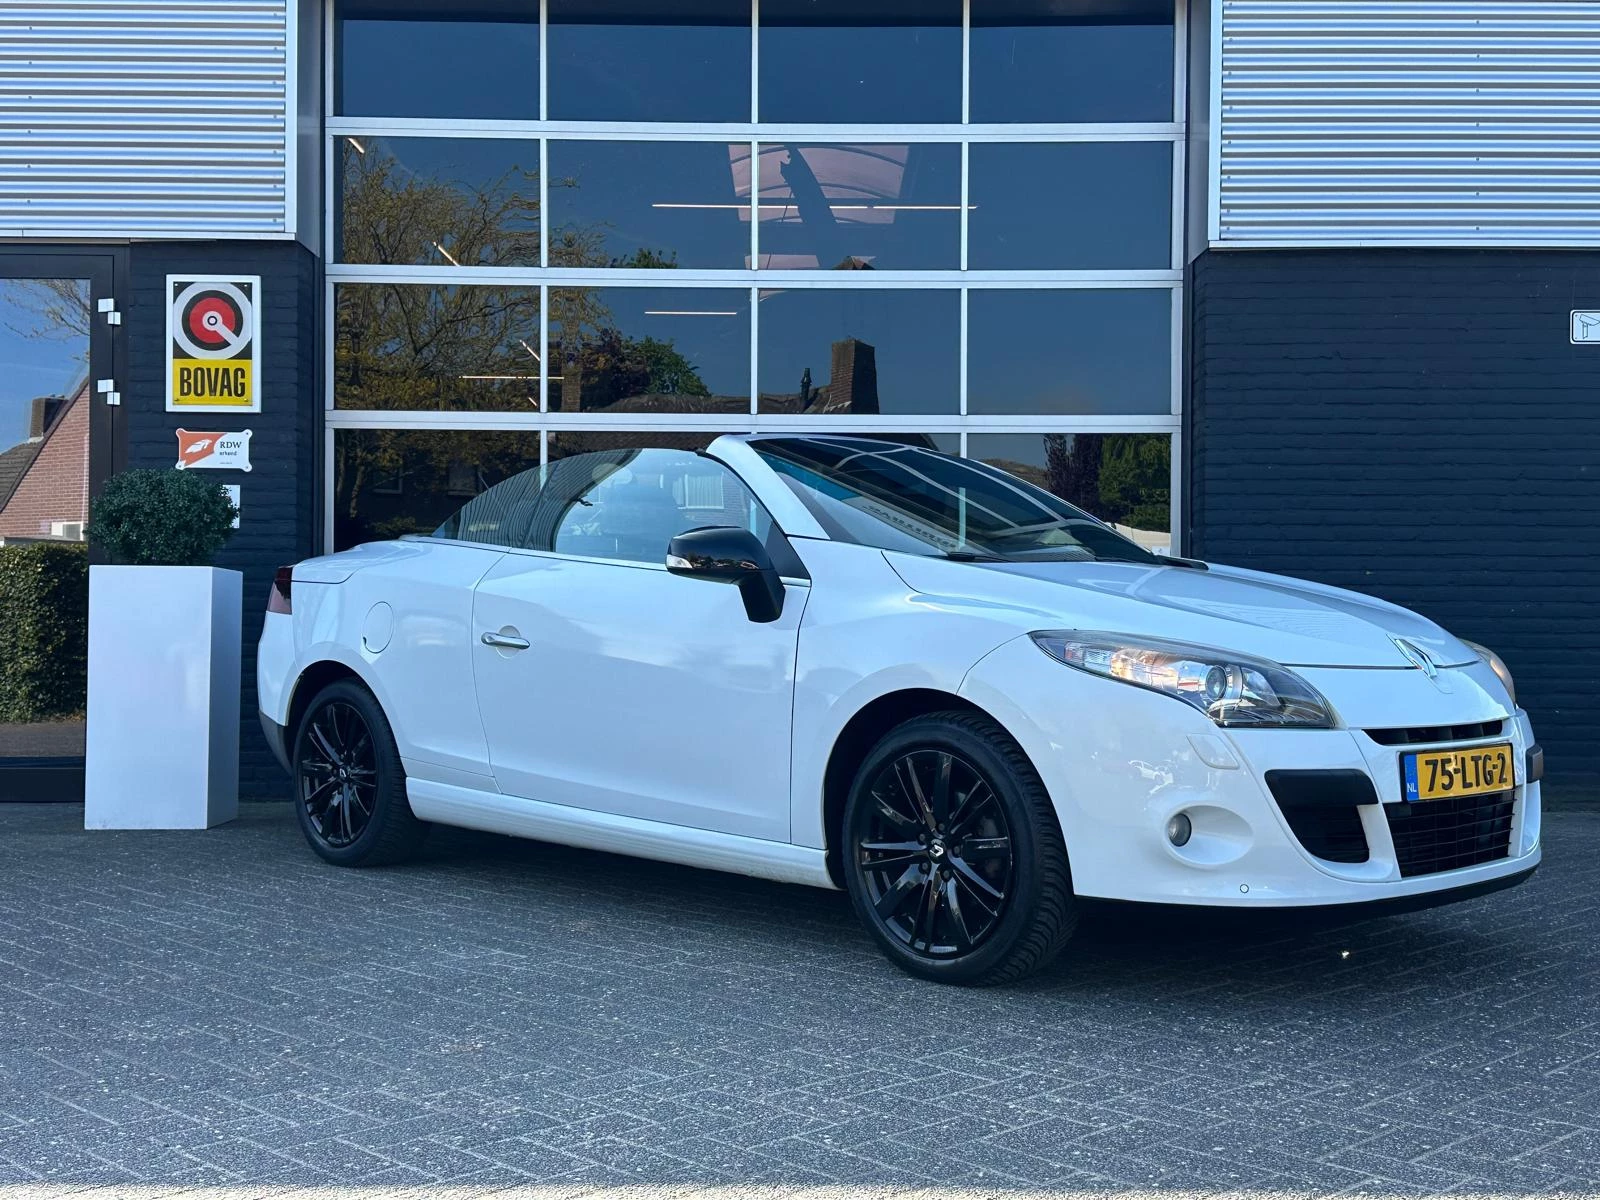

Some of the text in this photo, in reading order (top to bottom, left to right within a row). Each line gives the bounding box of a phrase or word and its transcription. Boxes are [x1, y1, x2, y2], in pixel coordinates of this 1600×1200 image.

[180, 367, 245, 397] BOVAG
[220, 441, 242, 449] RDW
[1425, 752, 1507, 792] 75-LTG-2
[1407, 783, 1417, 793] NL
